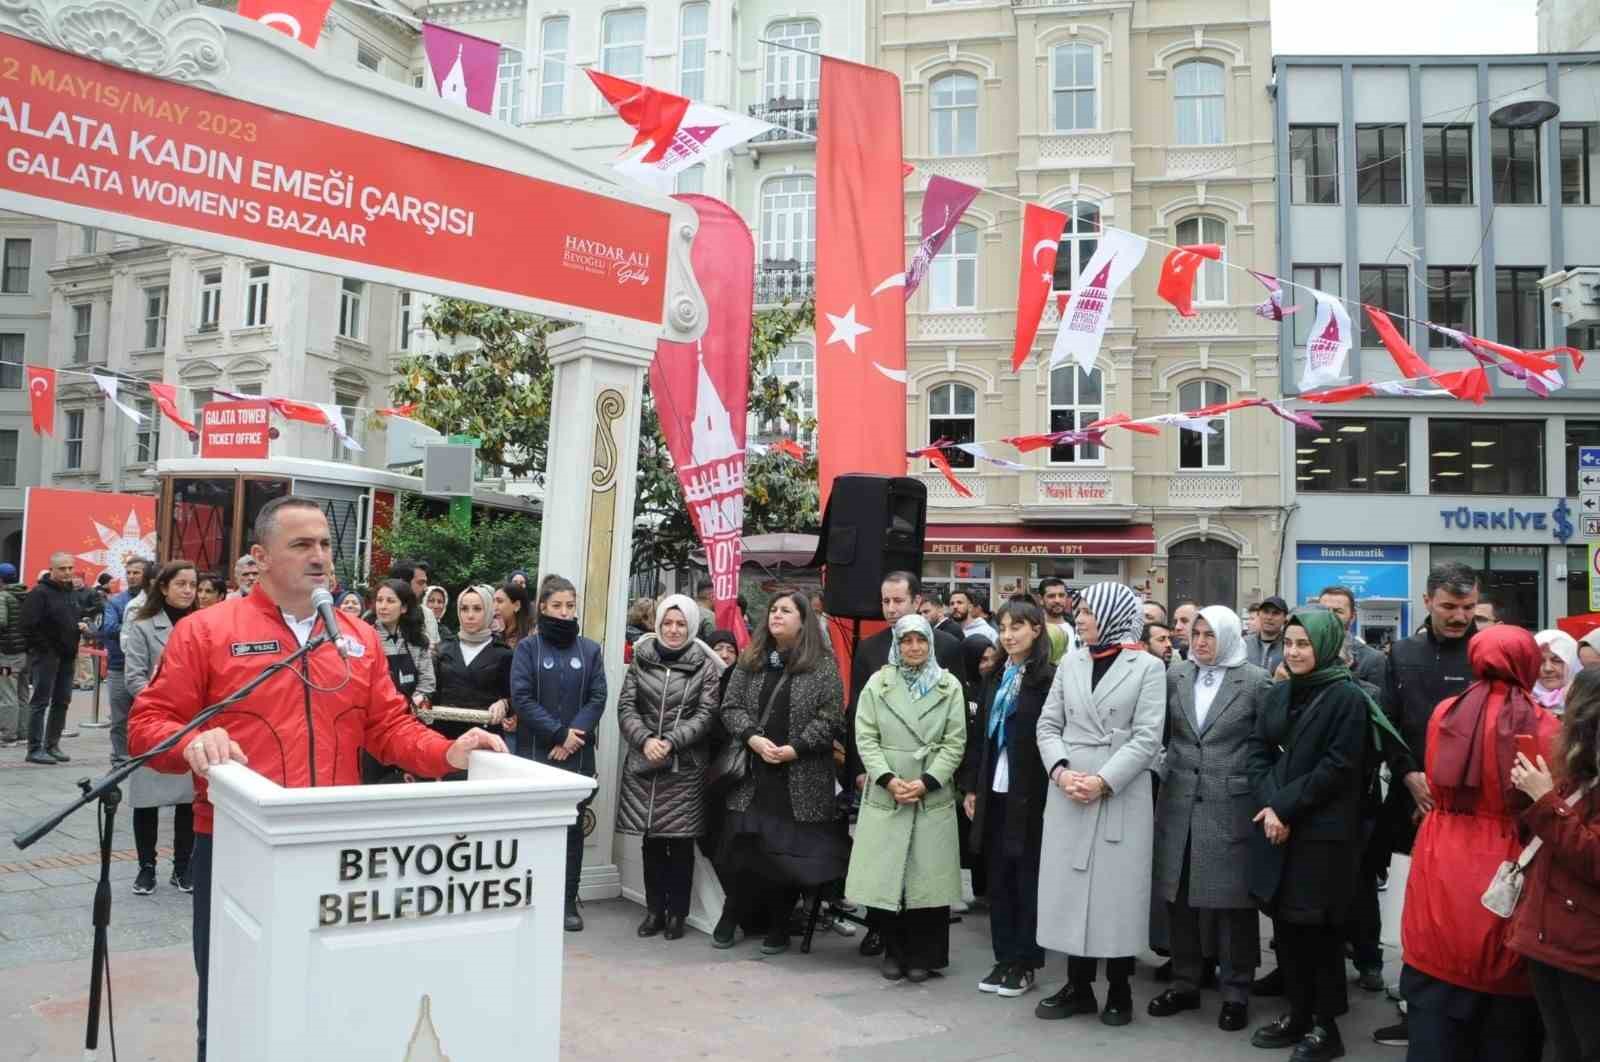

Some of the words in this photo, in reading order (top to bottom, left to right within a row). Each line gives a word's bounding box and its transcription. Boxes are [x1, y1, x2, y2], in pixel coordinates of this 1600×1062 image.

[3, 57, 20, 81] 2
[30, 64, 190, 125] MAYIS/MAY
[197, 110, 258, 142] 2023
[128, 130, 243, 185] KADIN
[251, 159, 354, 209] EMEĞİ
[360, 186, 476, 237] ÇARŞISI
[7, 147, 124, 195] GALATA
[131, 175, 261, 224] WOMEN'S
[266, 206, 368, 247] BAZAAR
[565, 235, 625, 261] HAYDAR
[205, 409, 236, 425] GALATA
[238, 408, 266, 424] TOWER
[208, 432, 235, 445] TICKET
[235, 431, 262, 445] OFFICE
[1440, 506, 1548, 530] TÜRKİYE
[931, 543, 965, 553] PETEK
[1009, 544, 1049, 554] GALATA
[1059, 544, 1084, 554] 1971
[1320, 546, 1385, 558] Bankamatik
[338, 834, 519, 883] BEYOĞLU
[319, 869, 534, 928] BELEDİYESİ
